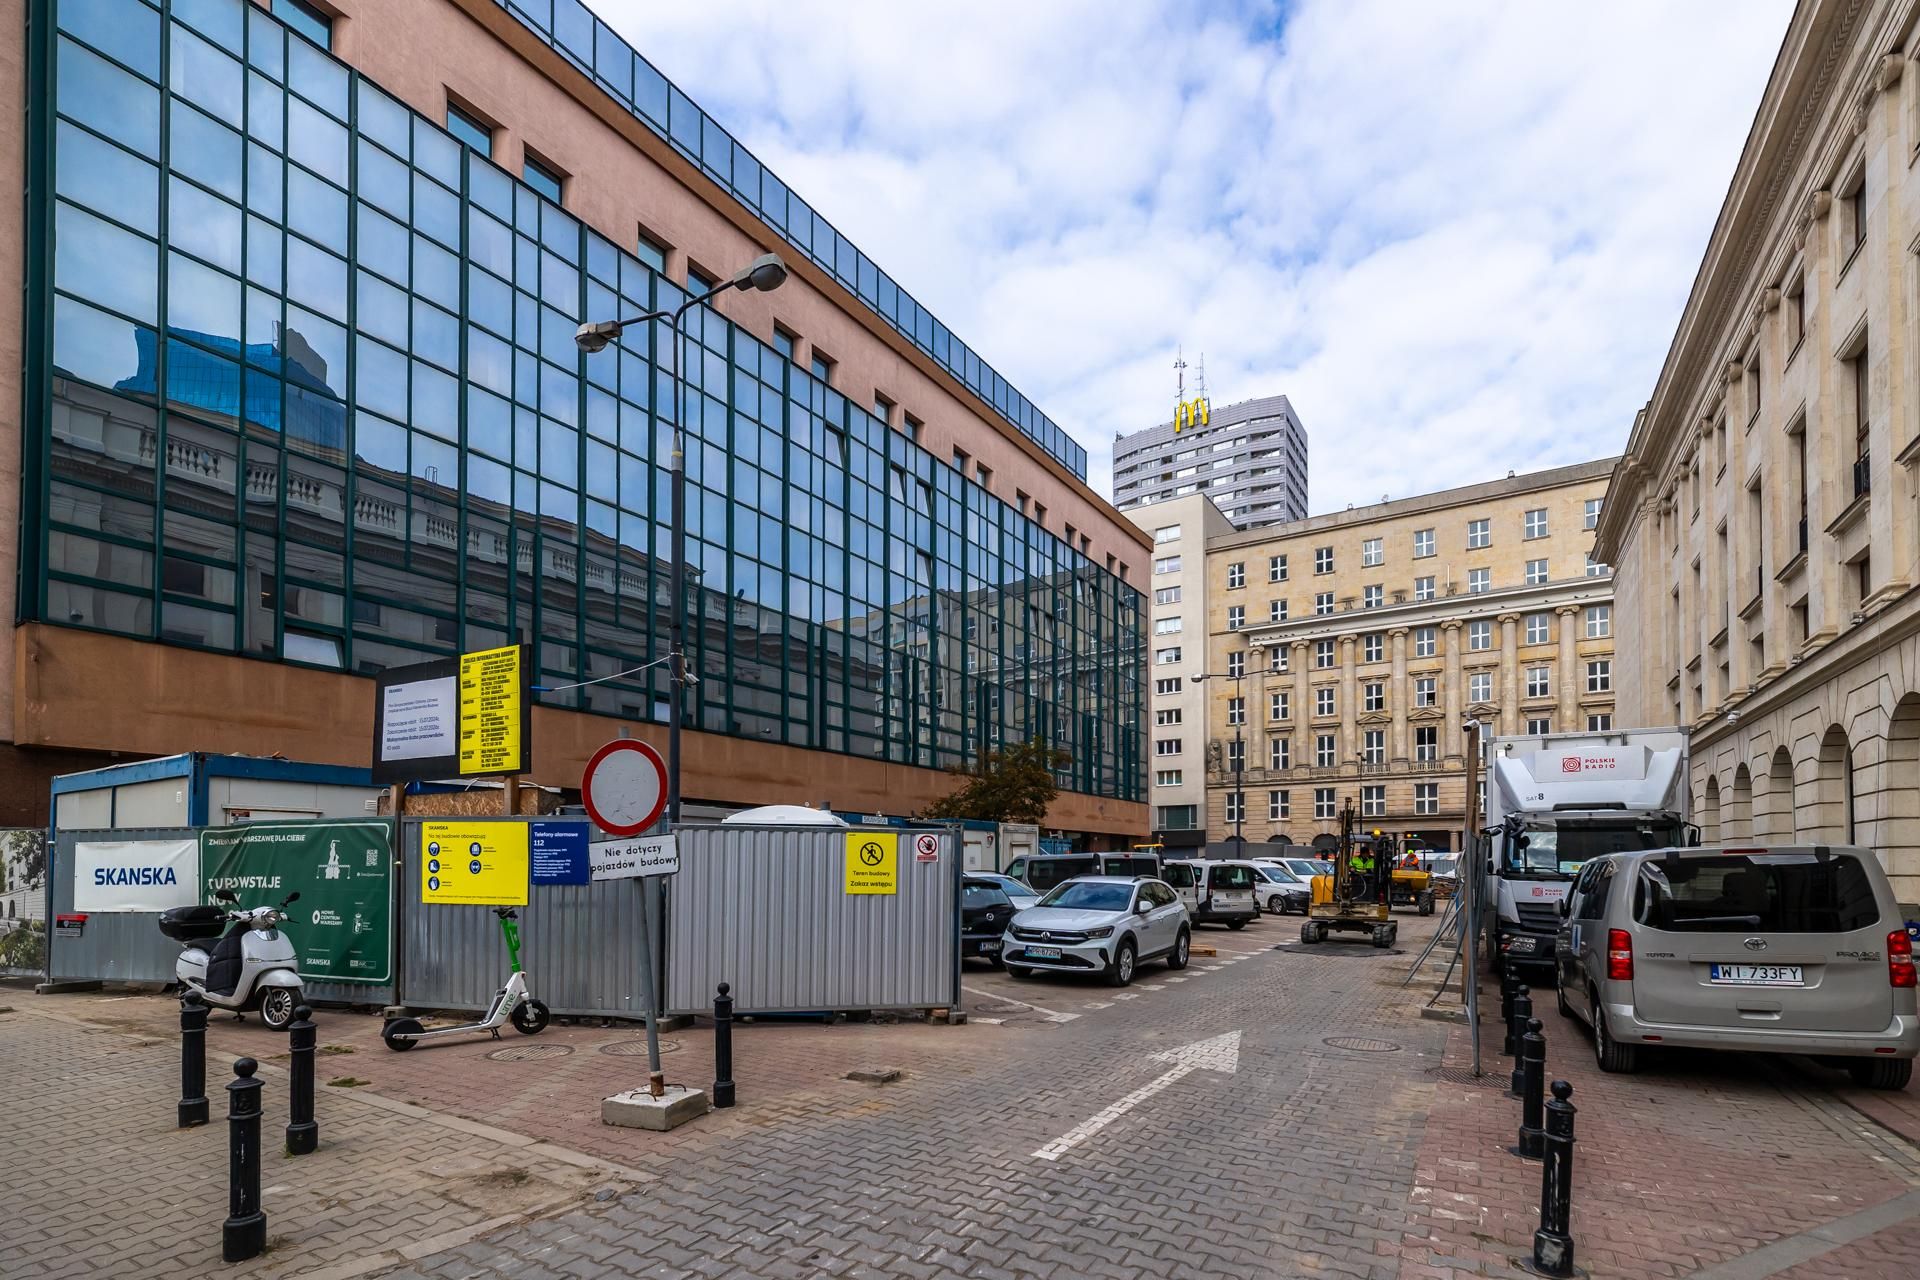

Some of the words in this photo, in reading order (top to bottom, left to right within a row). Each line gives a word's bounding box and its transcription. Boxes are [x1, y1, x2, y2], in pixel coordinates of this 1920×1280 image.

[1537, 792, 1545, 801] 8
[274, 834, 287, 842] DLA
[286, 834, 306, 842] CIEBIE
[533, 839, 545, 847] 112
[604, 848, 621, 858] Nie
[626, 844, 662, 856] dotyczy
[590, 859, 635, 875] pojazdów
[640, 855, 678, 868] budowy
[94, 867, 177, 886] SKANSKA
[224, 876, 281, 889] POWSTAJE
[306, 957, 331, 967] SKANSKA
[1721, 965, 1742, 979] WI
[1749, 966, 1800, 980] 733FY
